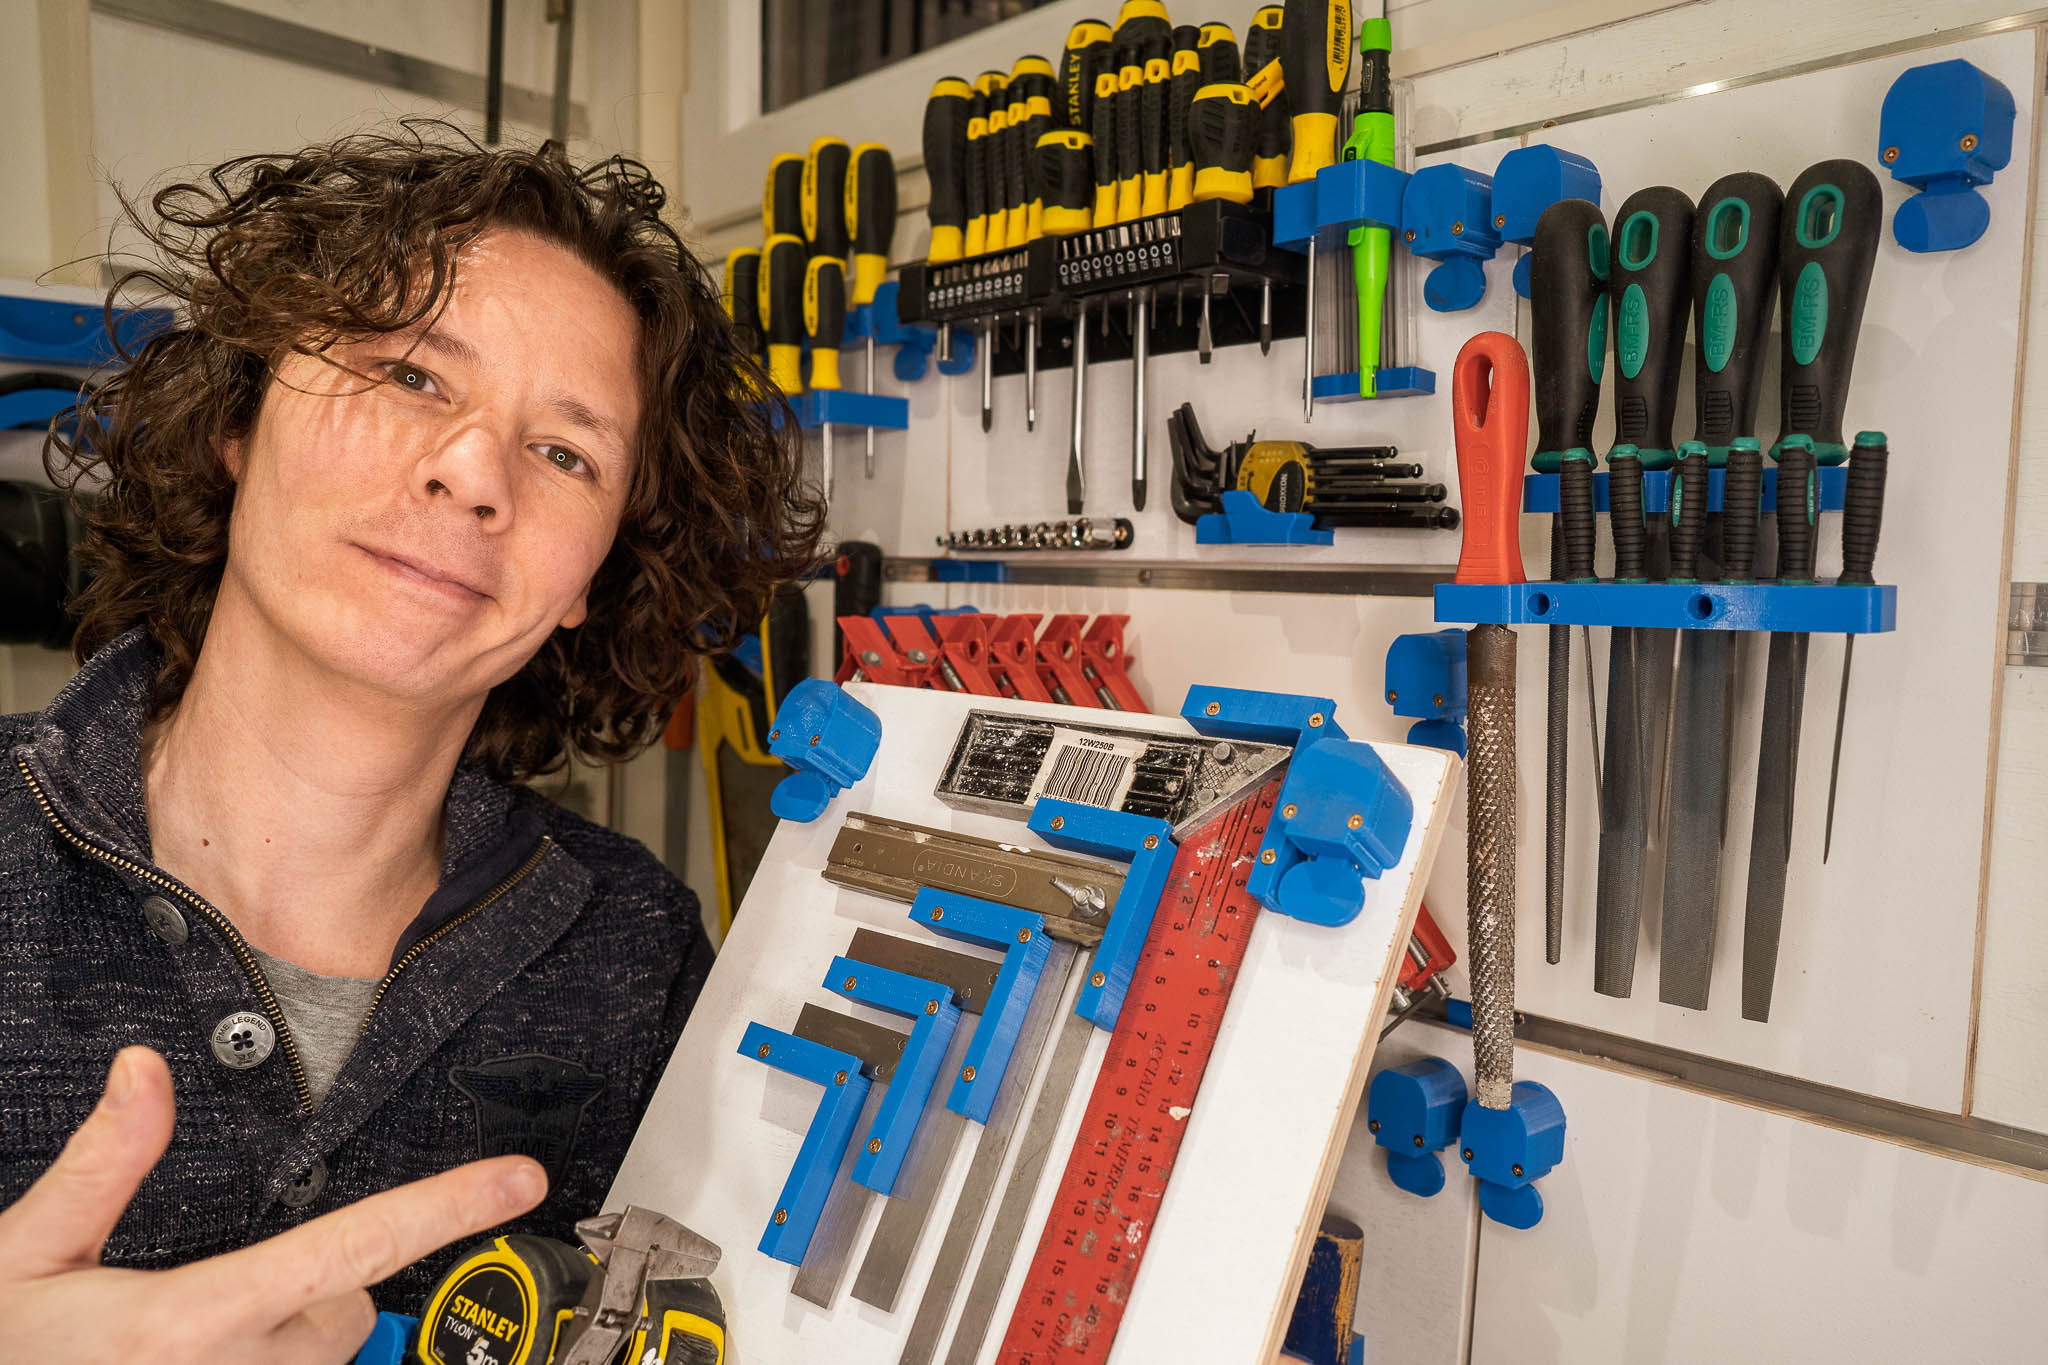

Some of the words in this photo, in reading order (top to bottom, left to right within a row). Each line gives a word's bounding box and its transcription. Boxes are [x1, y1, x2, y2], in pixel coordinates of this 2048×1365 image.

[1069, 54, 1082, 126] STANLEY
[1710, 288, 1729, 356] BM-RS
[1800, 279, 1820, 351] BM-RS
[1624, 298, 1640, 363] BM-RS
[1280, 473, 1288, 512] PROXXON
[1079, 737, 1115, 751] 12W250B
[1260, 801, 1273, 809] 2
[1252, 826, 1264, 835] 3
[927, 859, 1003, 888] SKANDIA
[1235, 879, 1246, 888] 5
[1182, 895, 1193, 905] 2
[1226, 905, 1237, 914] 6
[1173, 922, 1184, 931] 3
[1217, 932, 1229, 942] 7
[1164, 948, 1175, 957] 4
[1208, 959, 1219, 968] 8
[1155, 975, 1166, 985] 5
[1198, 987, 1209, 996] 9
[1145, 1003, 1156, 1012] 6
[216, 1023, 230, 1041] PME
[231, 1016, 267, 1031] LEGEND
[1187, 1013, 1201, 1029] 10
[1136, 1031, 1147, 1041] 7
[1178, 1039, 1192, 1055] 11
[1126, 1057, 1137, 1068] 8
[1135, 1033, 1167, 1106] ACCIAIO
[1168, 1068, 1182, 1086] 12
[1116, 1087, 1127, 1097] 9
[1158, 1097, 1172, 1115] 13
[1104, 1113, 1118, 1129] 10
[1149, 1126, 1163, 1143] 14
[1095, 1140, 1109, 1157] 11
[1094, 1117, 1141, 1225] TEMPERATO
[1138, 1155, 1153, 1173] 15
[1083, 1170, 1098, 1188] 12
[1128, 1185, 1142, 1203] 16
[1074, 1199, 1088, 1216] 13
[1119, 1215, 1132, 1233] 17
[1063, 1228, 1077, 1246] 14
[1106, 1245, 1121, 1263] 18
[1052, 1258, 1067, 1276] 15
[1095, 1276, 1111, 1294] 19
[450, 1294, 519, 1343] STANLEY
[445, 1315, 474, 1340] TYLON
[1031, 1320, 1045, 1338] 17
